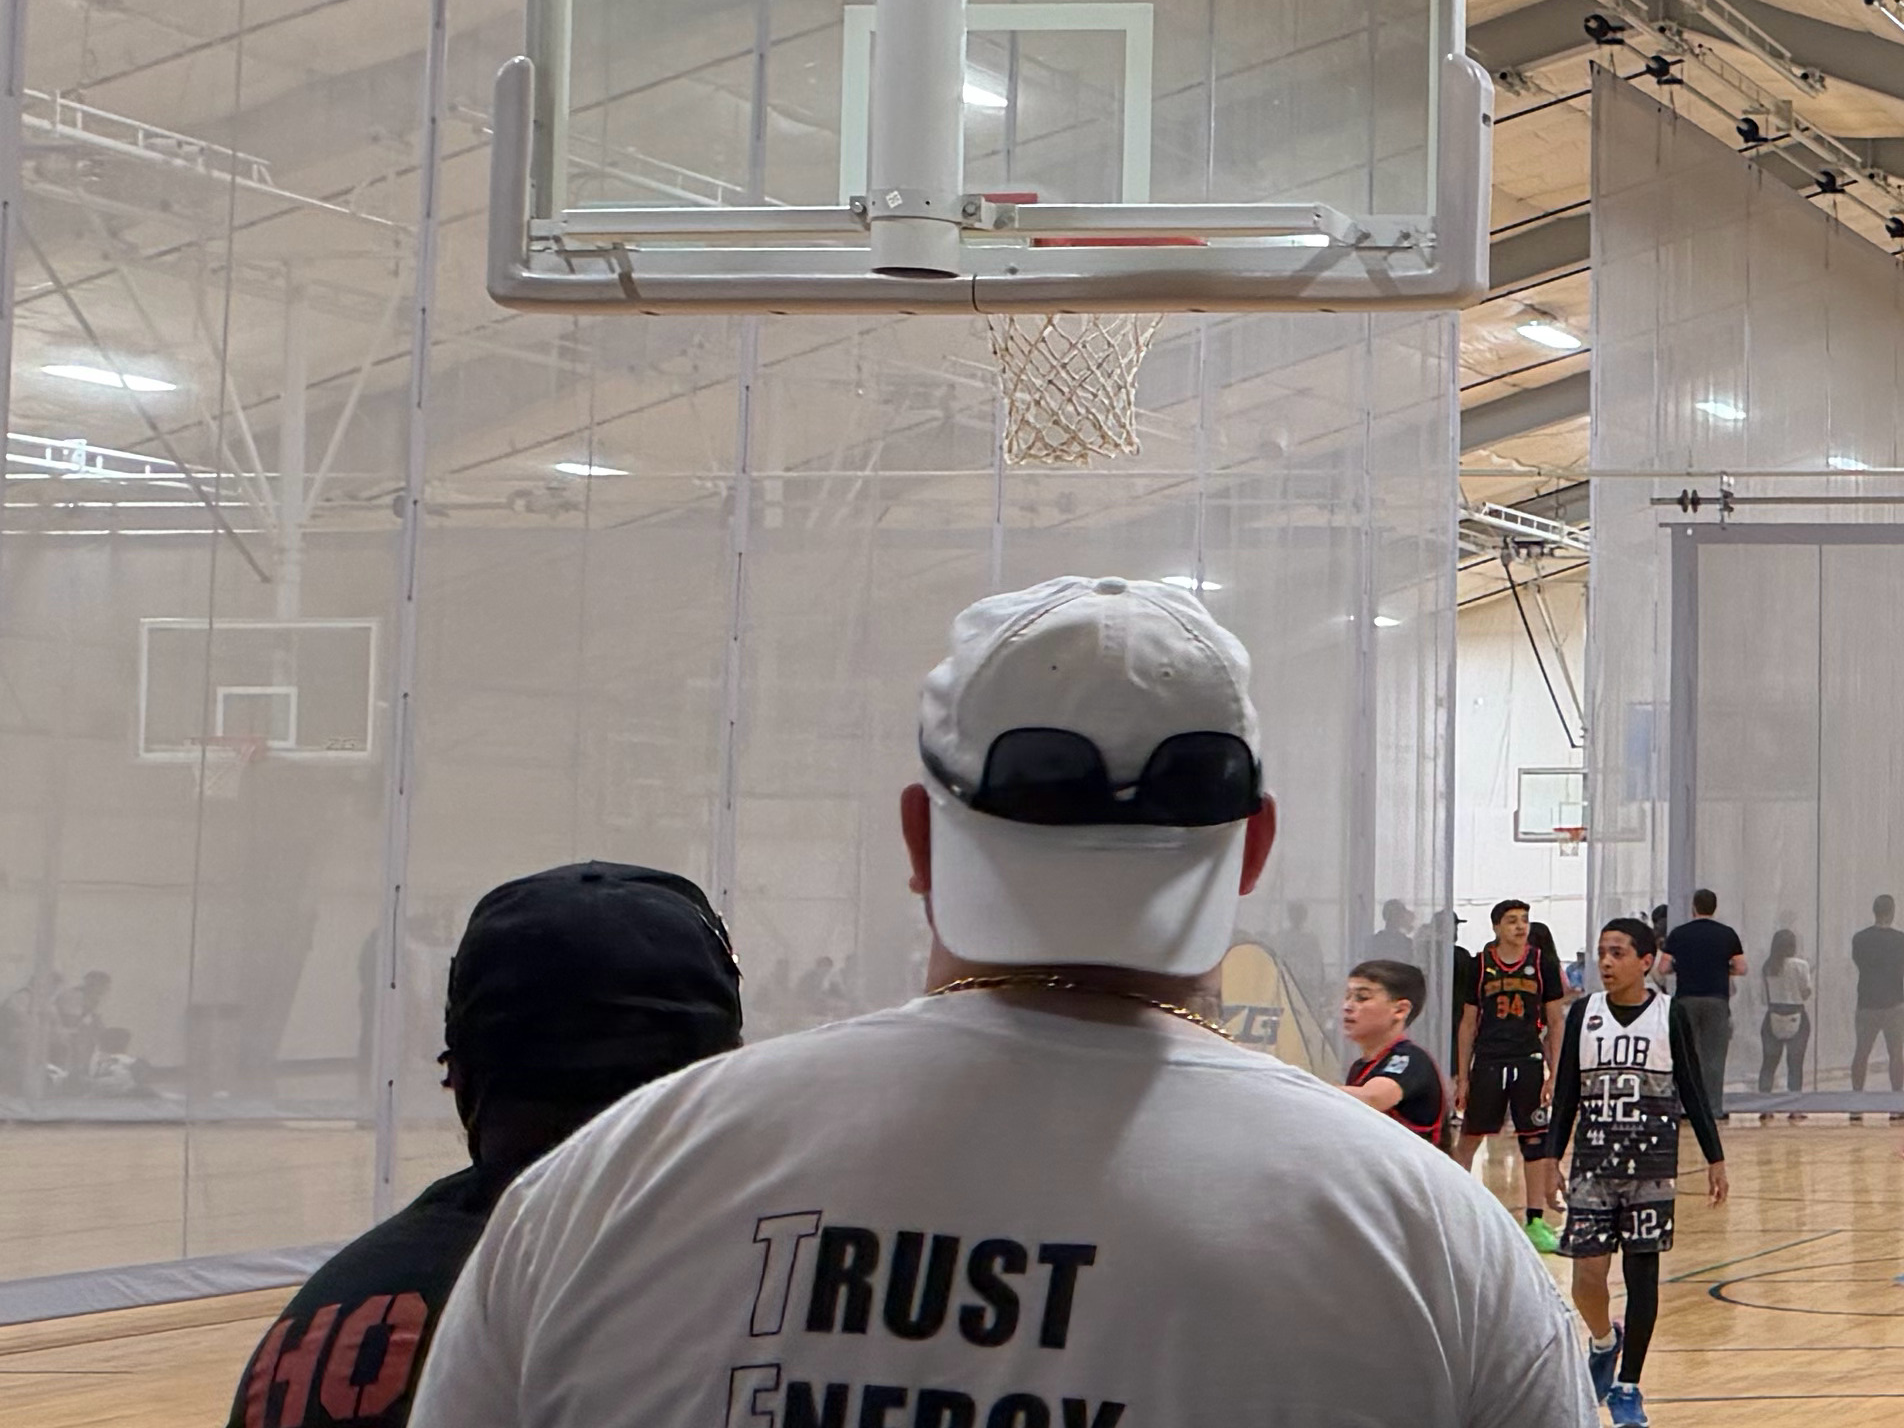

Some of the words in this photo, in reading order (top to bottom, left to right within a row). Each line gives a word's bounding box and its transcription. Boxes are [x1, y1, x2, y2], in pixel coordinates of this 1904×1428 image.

[1497, 994, 1525, 1020] 34
[1596, 1035, 1650, 1067] LOB
[1598, 1074, 1642, 1122] 12
[1631, 1208, 1658, 1240] 12
[749, 1210, 1098, 1349] TRUST
